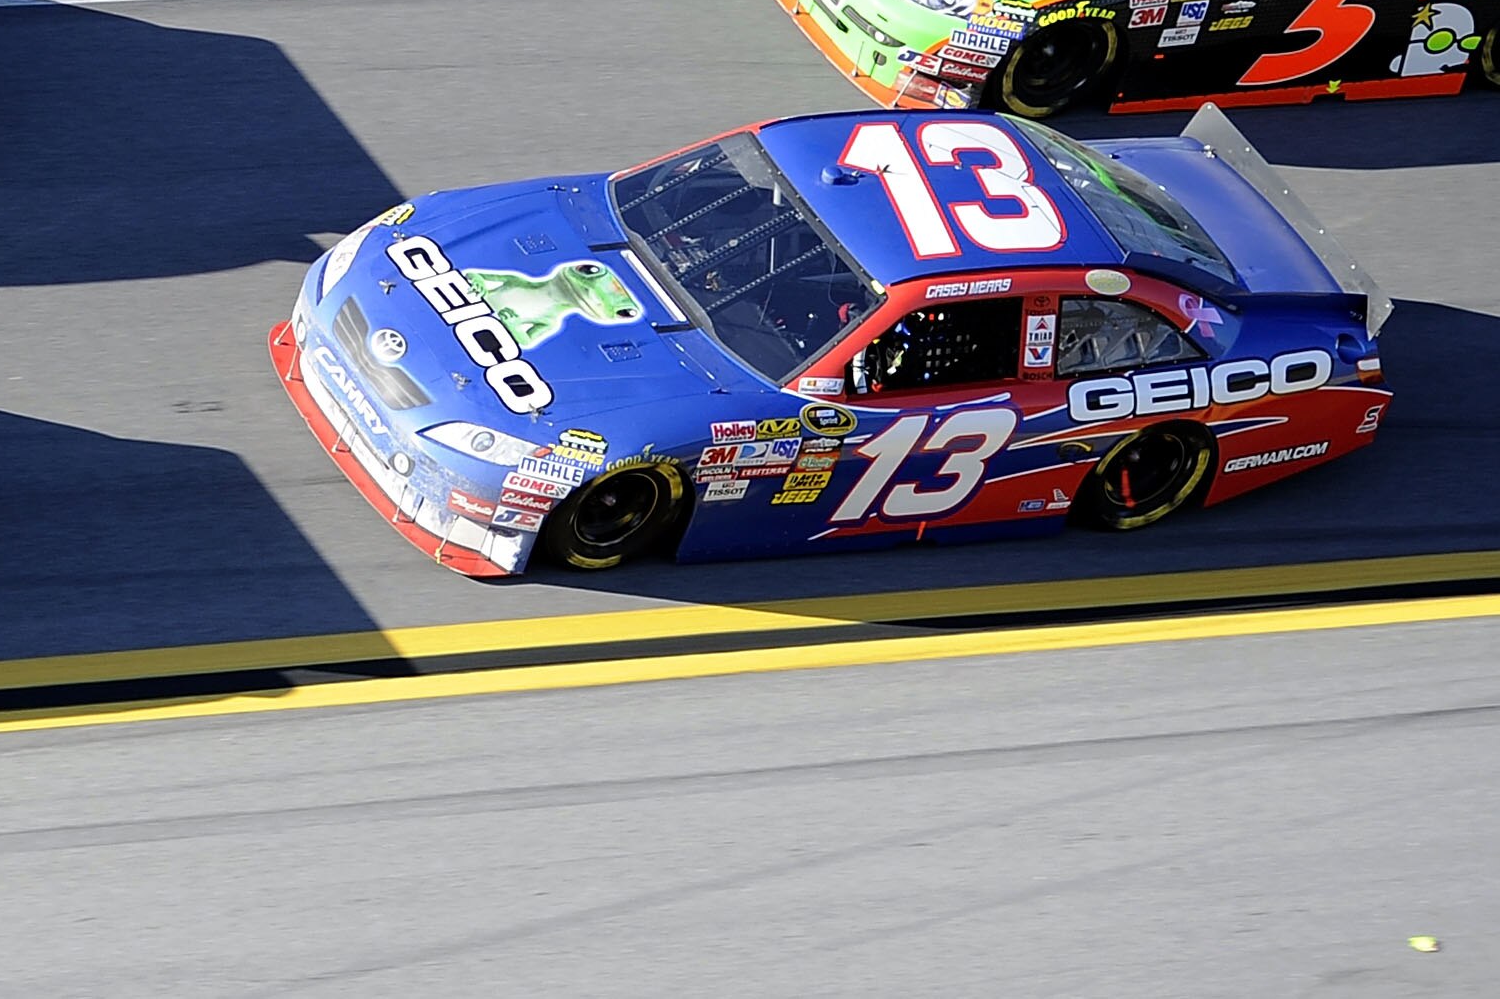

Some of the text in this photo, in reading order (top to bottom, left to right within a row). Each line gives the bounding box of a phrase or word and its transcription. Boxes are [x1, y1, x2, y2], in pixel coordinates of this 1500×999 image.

[1038, 0, 1117, 28] GOODYEAR
[1131, 7, 1165, 27] 3M
[1181, 2, 1209, 20] USG
[969, 14, 1025, 33] MOOG
[1209, 16, 1254, 31] JEGS
[951, 30, 1008, 53] MAHLE
[1163, 34, 1197, 43] TISSOT
[943, 46, 986, 64] COMP
[838, 121, 1067, 261] 13
[926, 278, 1012, 299] CASEY MEARS
[385, 235, 555, 415] GEICO
[1029, 331, 1053, 341] TRIAD
[312, 346, 392, 438] CAMRY
[1067, 348, 1334, 423] GEICO
[713, 422, 755, 439] Holley
[700, 446, 738, 466] 3M
[772, 439, 799, 459] USG
[1223, 441, 1330, 473] GERMAIN.COM
[520, 457, 583, 484] MAHLE
[697, 467, 733, 476] LINCOLN
[740, 466, 791, 478] CRAFTSMAN
[830, 406, 1021, 525] 13
[508, 474, 558, 494] COMP
[707, 487, 745, 497] TISSOT
[771, 490, 822, 505] JEGS
[494, 510, 540, 527] JE
